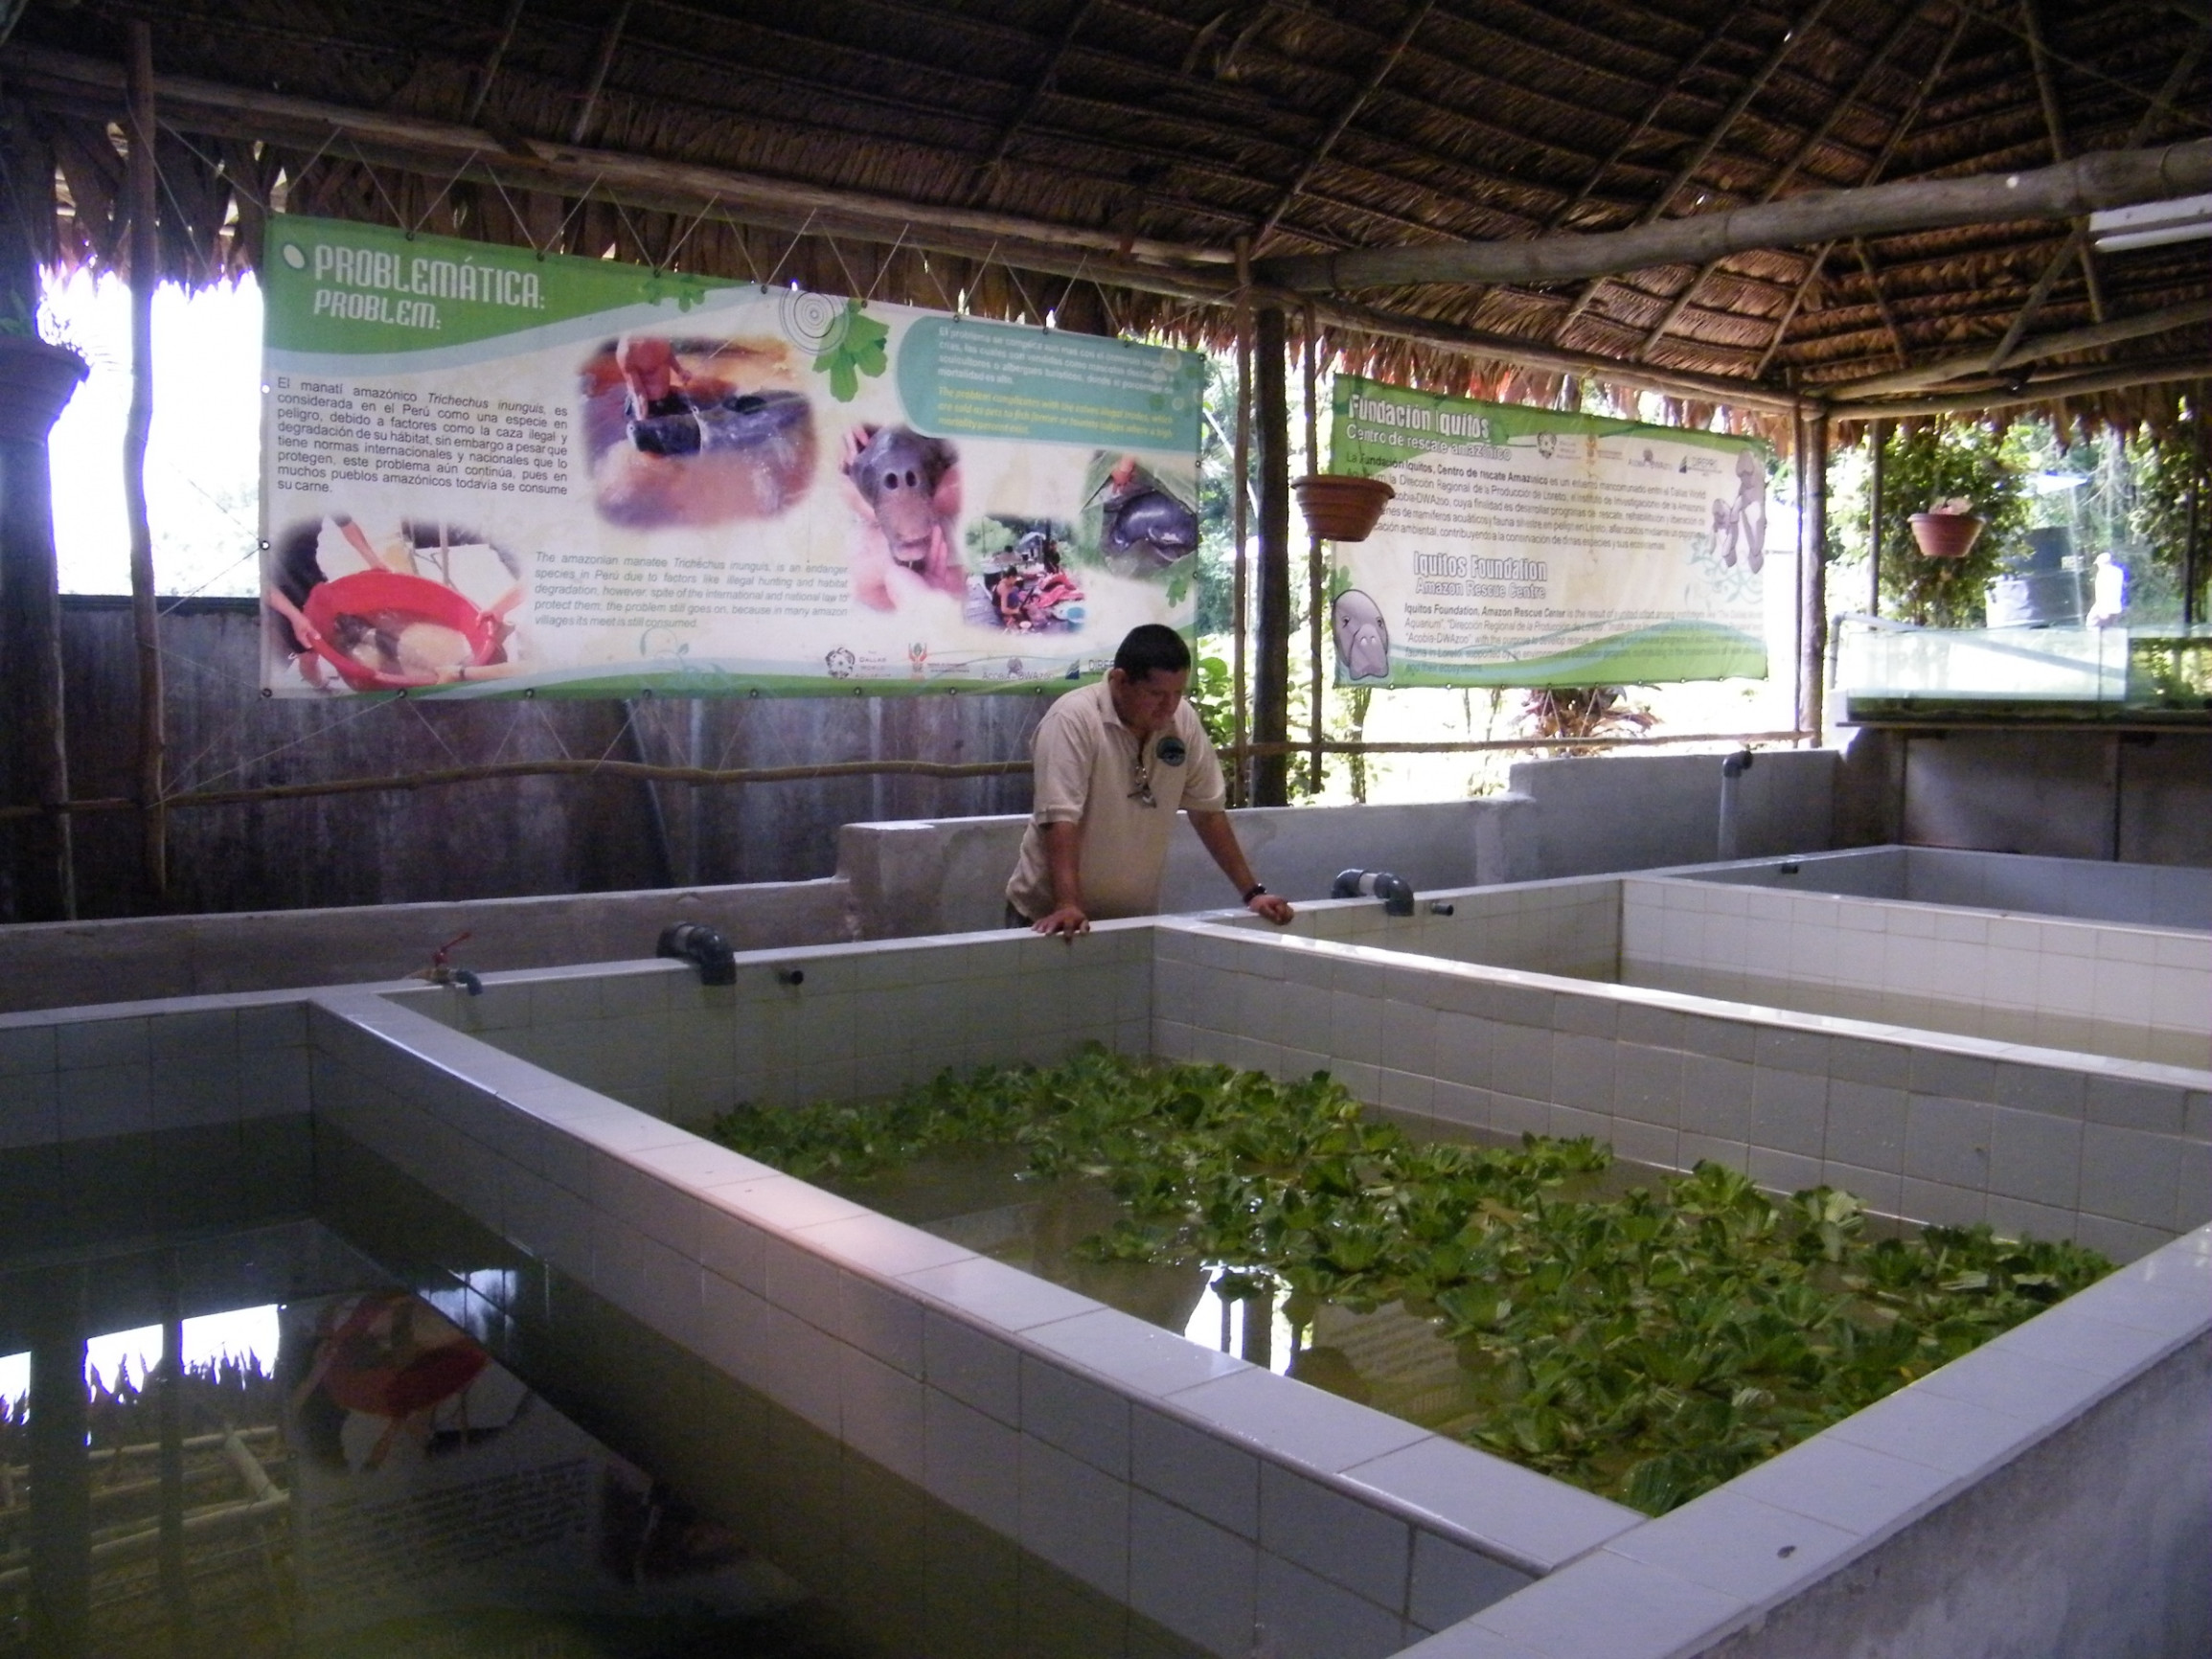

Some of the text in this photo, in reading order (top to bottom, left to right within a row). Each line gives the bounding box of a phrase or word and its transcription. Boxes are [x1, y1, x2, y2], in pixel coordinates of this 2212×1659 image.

[314, 244, 546, 309] PROBLEMÁTICA:
[314, 289, 442, 330] PROBLEM:
[276, 394, 568, 430] considerada en el Perú como una especie en
[277, 376, 290, 390] El
[300, 382, 343, 395] manatí
[352, 387, 418, 401] amazónico
[427, 391, 489, 408] Trichechus
[554, 405, 568, 416] es
[276, 407, 567, 444] peligro, debido a factores como la caza ilegal y
[1348, 394, 1491, 439] Fundación Iquitos
[277, 420, 353, 438] degradación
[354, 426, 371, 440] de
[373, 430, 388, 441] su
[434, 433, 452, 446] sin
[453, 435, 504, 452] embargo
[505, 441, 513, 451] a
[514, 442, 545, 454] pesar
[546, 444, 567, 457] que
[277, 435, 568, 469] tiene normas internacionales y nacionales que lo
[1346, 423, 1386, 444] Centro
[1389, 432, 1404, 446] de
[1407, 436, 1448, 454] rescate
[277, 465, 327, 478] muchos
[330, 467, 378, 482] pueblos
[381, 472, 452, 487] amazónicos
[500, 481, 515, 491] se
[517, 482, 567, 495] consume
[342, 455, 369, 467] este
[375, 457, 430, 472] problema
[435, 461, 458, 474] aún
[521, 468, 548, 482] pues
[553, 471, 567, 482] en
[1465, 466, 1478, 478] de
[277, 480, 292, 490] su
[1413, 551, 1548, 581] Iquitos Foundation
[1416, 578, 1464, 596] Amazon
[1466, 580, 1506, 598] Rescue
[1404, 602, 1432, 616] Iquitos
[1481, 604, 1512, 617] Amazon
